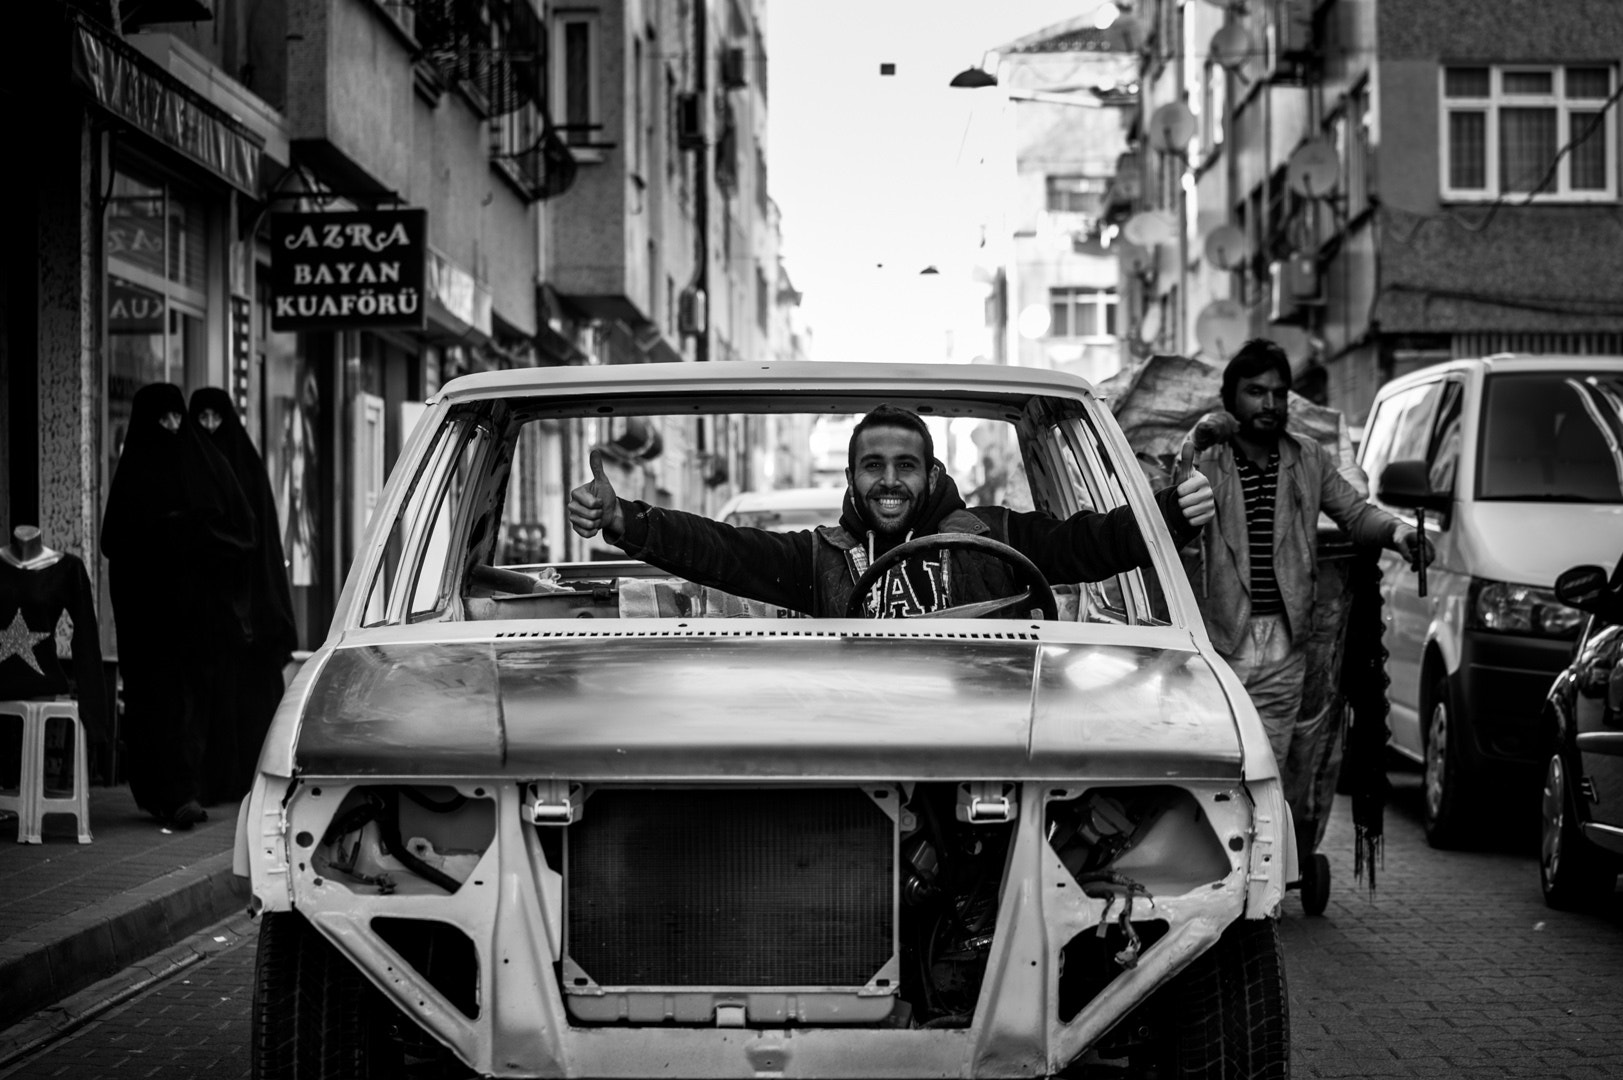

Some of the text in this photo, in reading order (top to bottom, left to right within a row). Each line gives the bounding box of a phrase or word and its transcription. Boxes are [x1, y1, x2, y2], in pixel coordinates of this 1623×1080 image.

[284, 222, 410, 252] AZRA
[294, 261, 400, 285] BAYAN
[275, 287, 418, 317] KUAFÖRÜ
